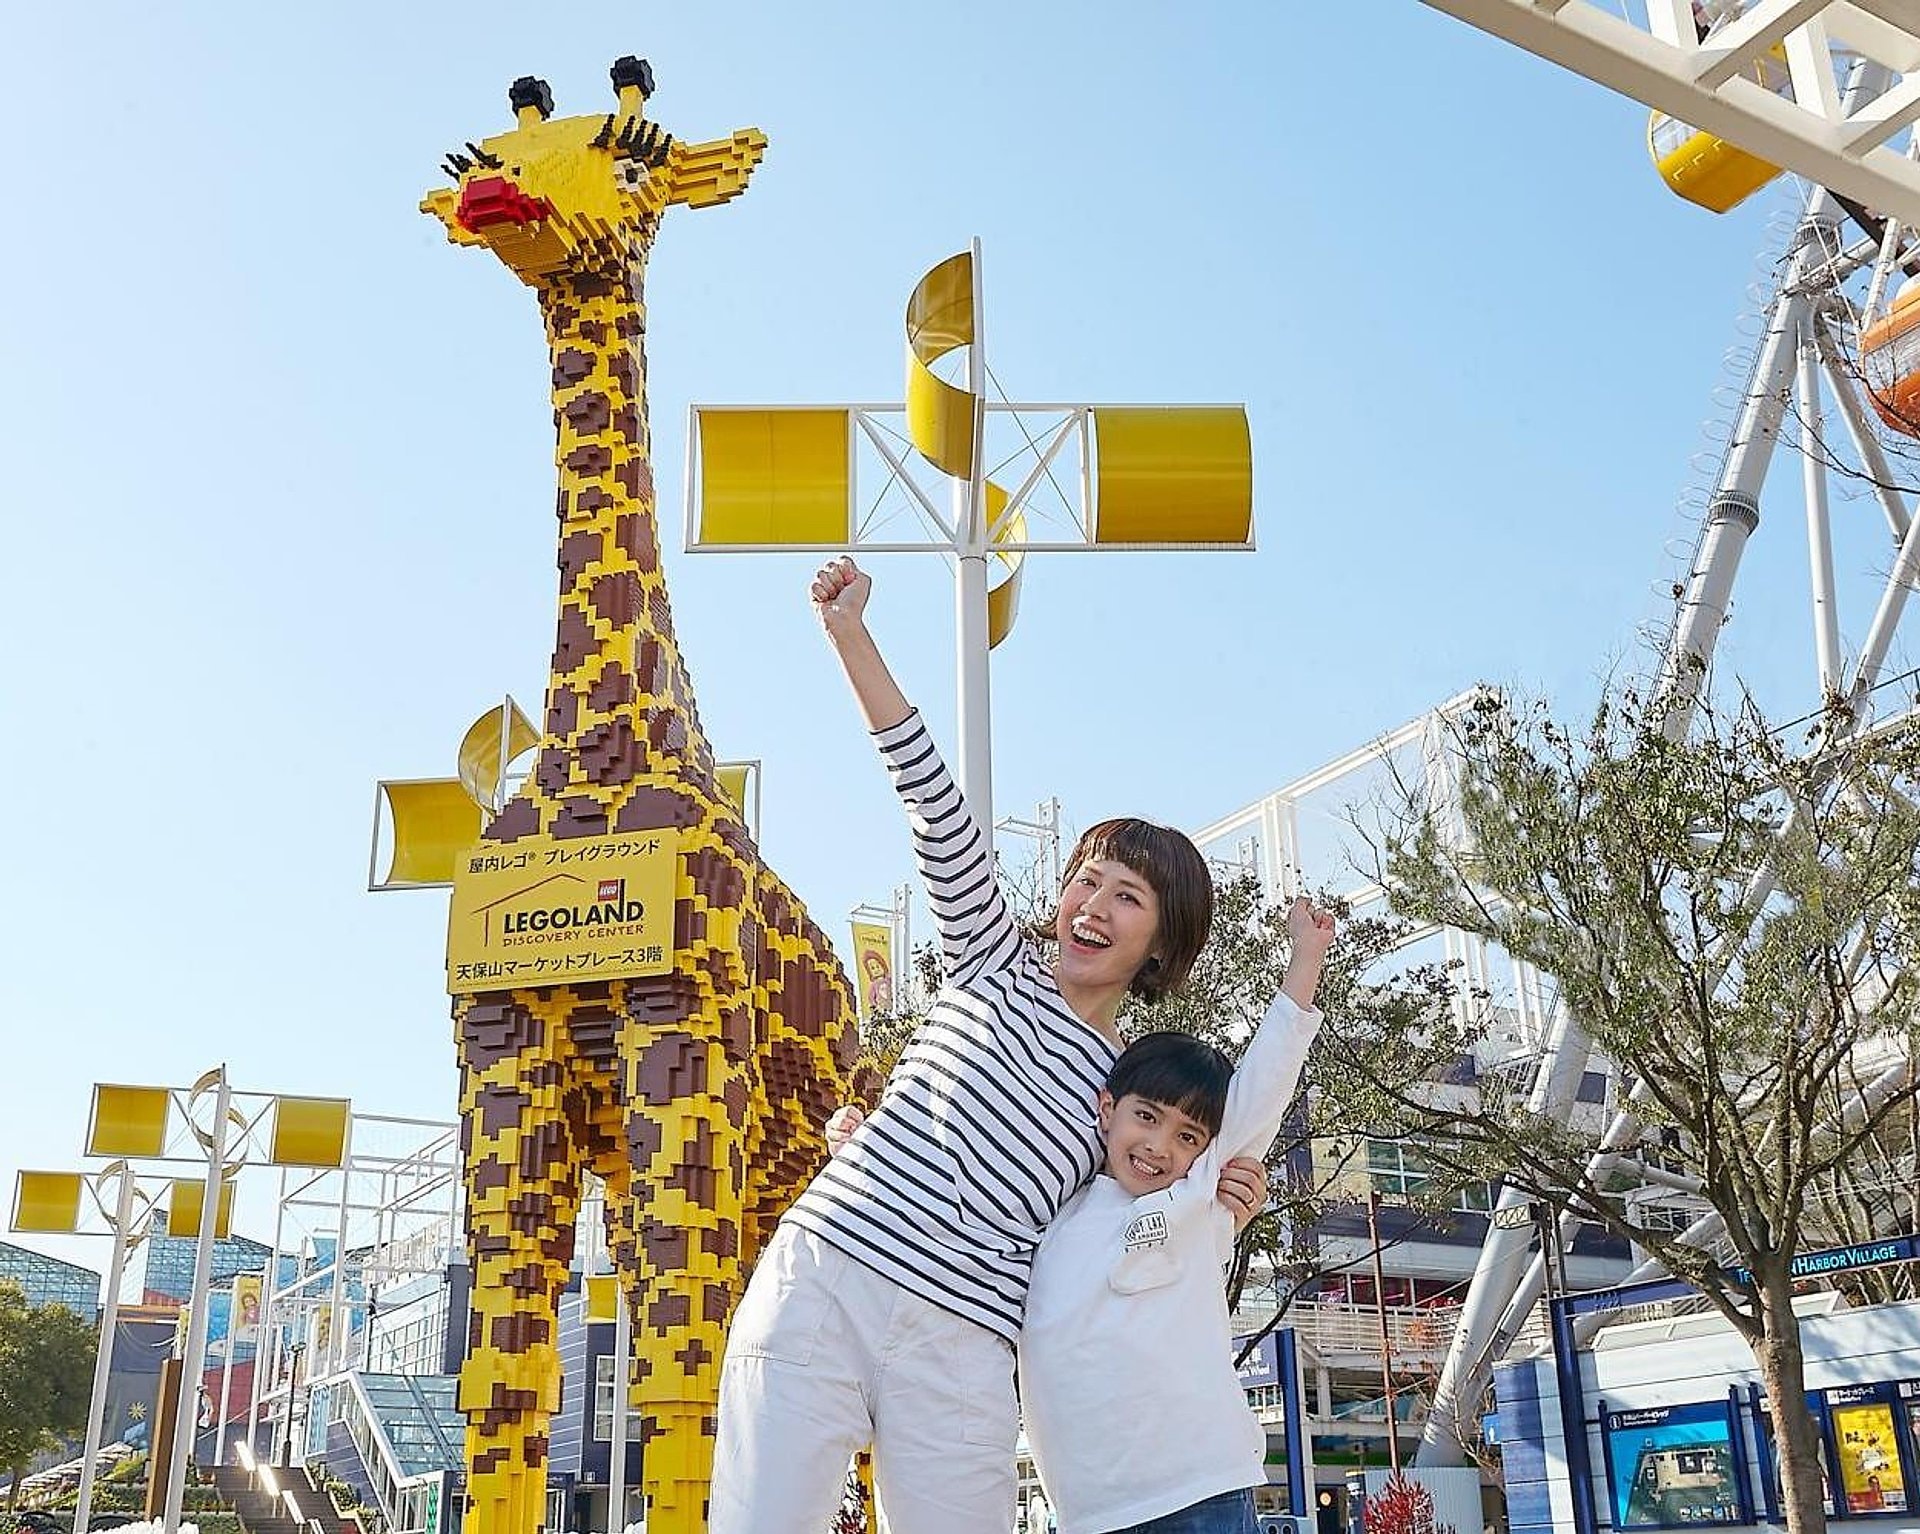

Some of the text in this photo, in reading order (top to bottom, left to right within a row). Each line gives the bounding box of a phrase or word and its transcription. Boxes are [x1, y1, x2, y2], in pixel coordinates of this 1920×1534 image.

[544, 839, 661, 864] プレイグラウンド
[599, 885, 618, 896] LEGO
[503, 878, 644, 934] LEGOLAND
[503, 924, 644, 947] DISCOVERY CENTER
[456, 946, 663, 980] 天保山マーケットプレース3階
[1797, 1255, 1847, 1274] HARBOR
[1846, 1245, 1897, 1266] VILLAGE
